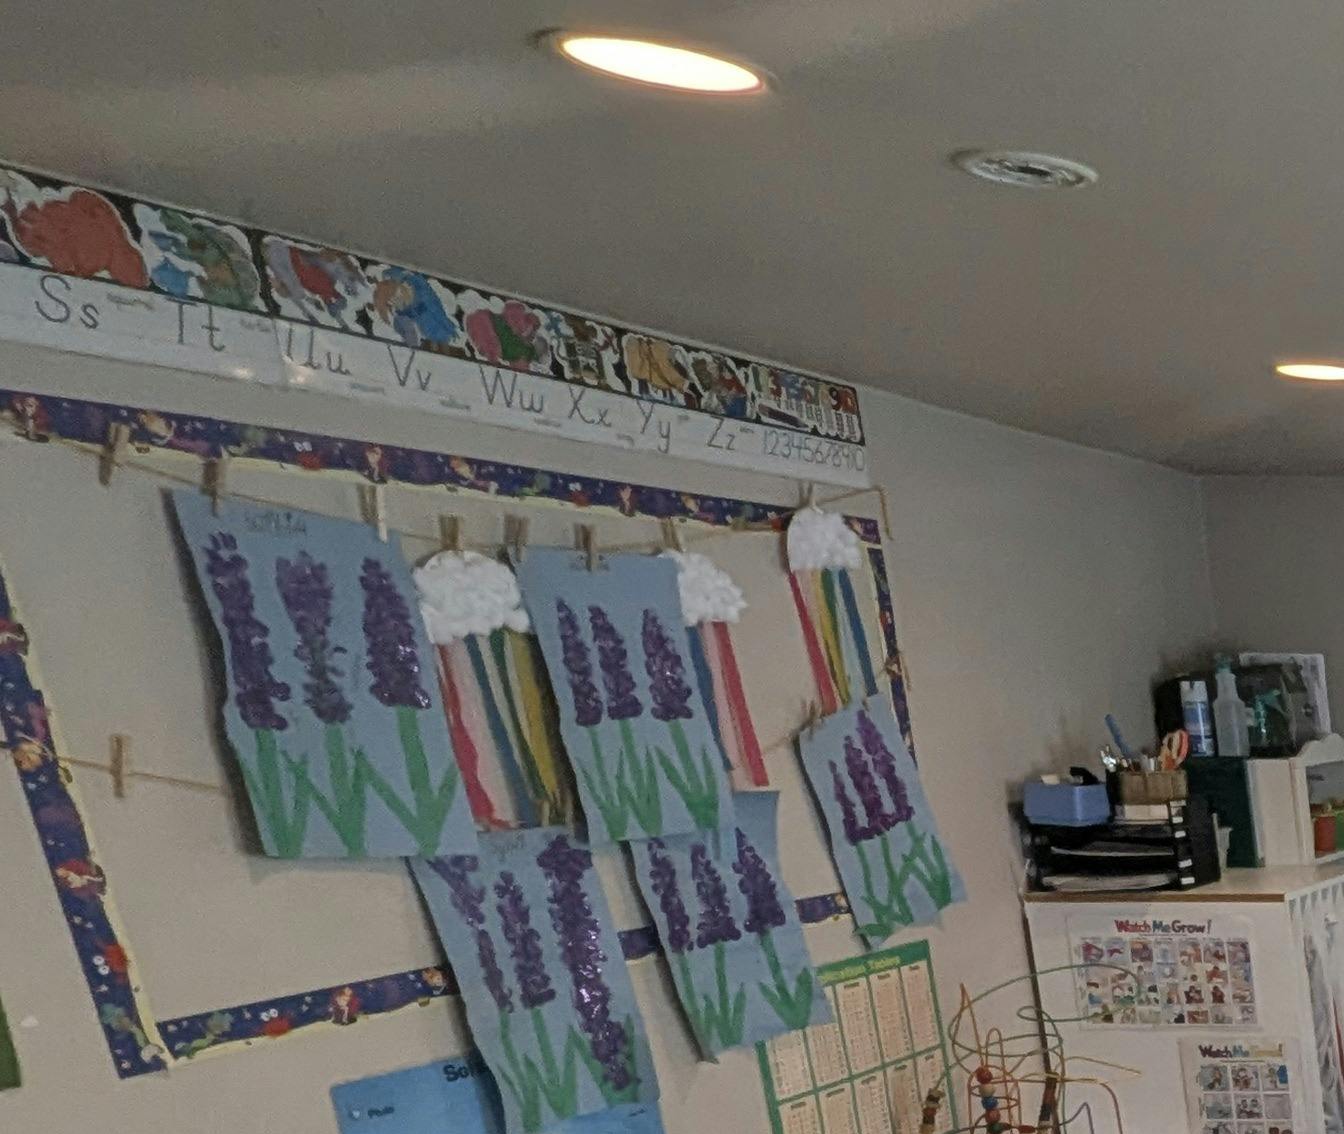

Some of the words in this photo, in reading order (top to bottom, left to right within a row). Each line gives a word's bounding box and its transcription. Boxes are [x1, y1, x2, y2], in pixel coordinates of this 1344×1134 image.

[35, 274, 99, 330] Ss
[176, 300, 227, 353] Tt
[285, 324, 351, 377] Uu
[386, 343, 432, 392] Vv
[479, 363, 544, 414] Ww
[567, 384, 612, 428] Xx
[636, 400, 671, 454] Yy
[706, 416, 736, 451] Zz
[1114, 919, 1151, 933] Watch
[1152, 919, 1171, 932] Me
[1198, 1044, 1232, 1059] Watch
